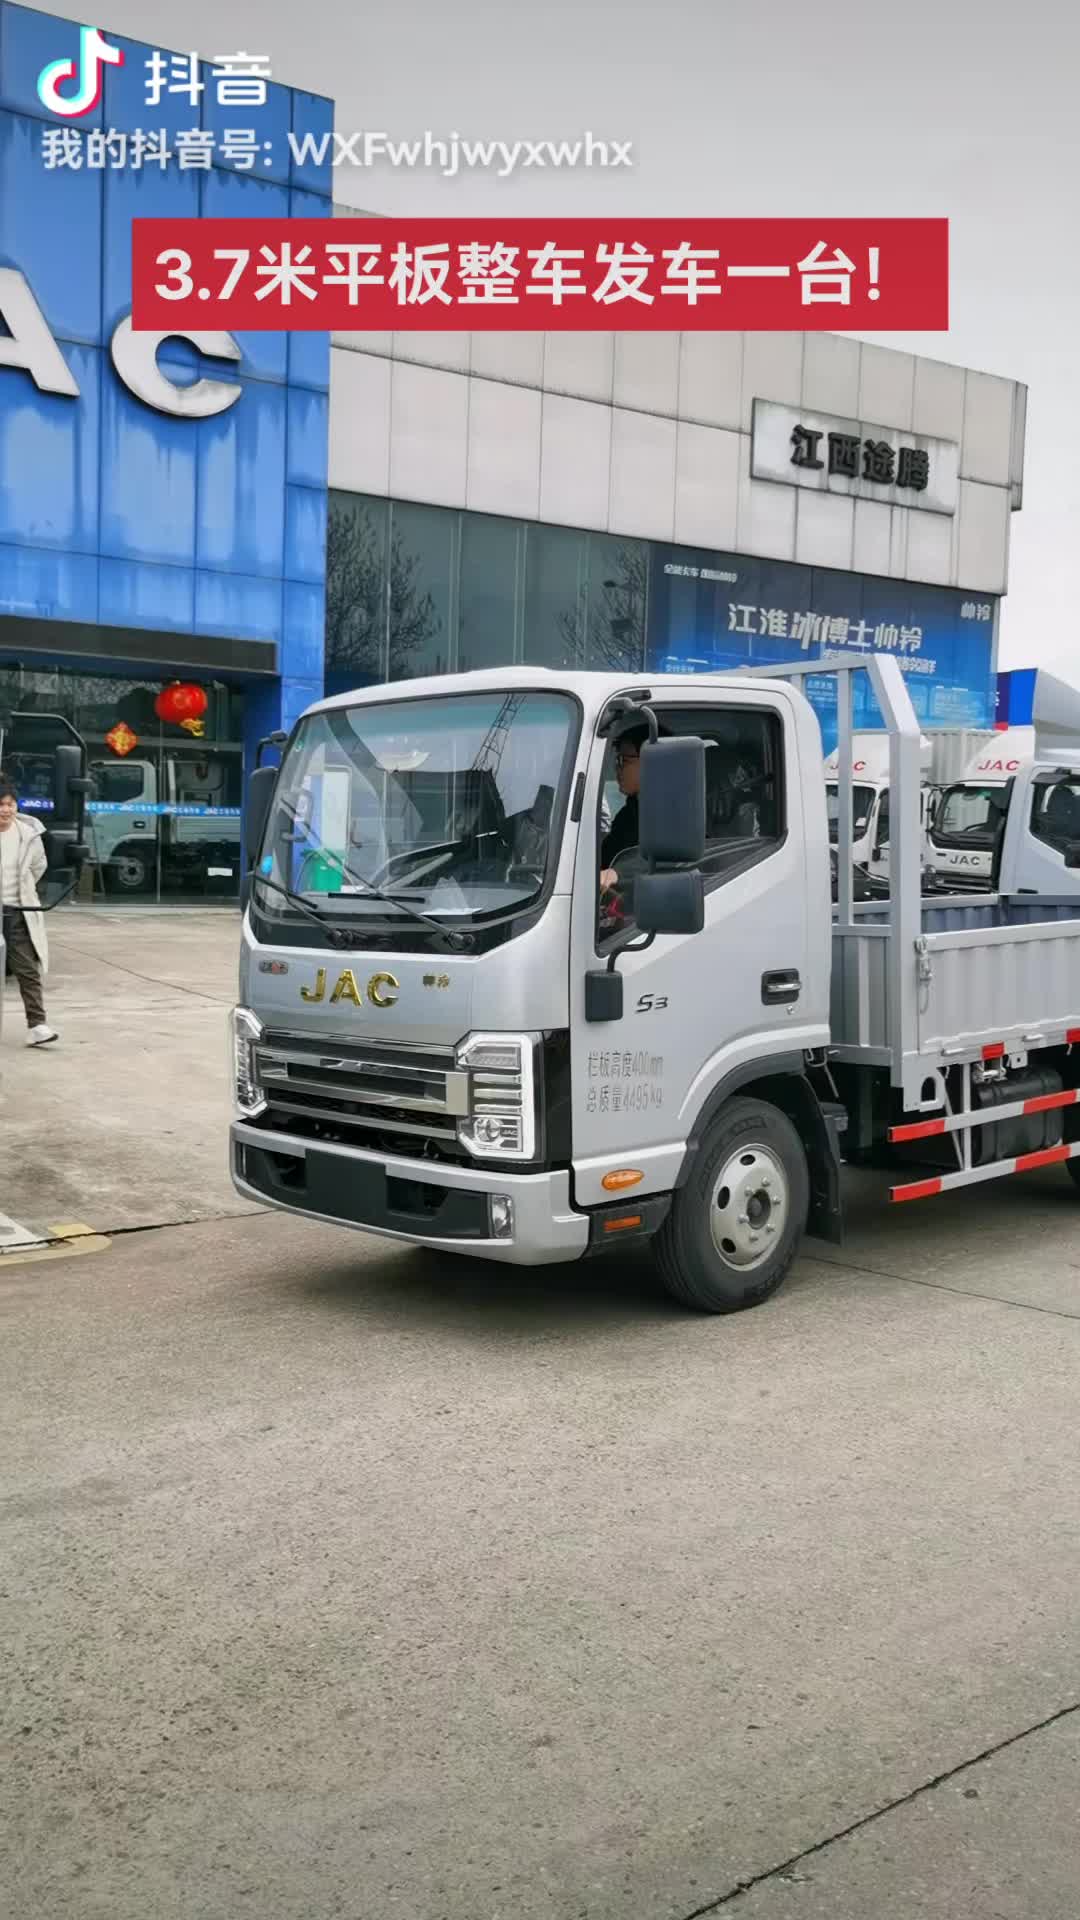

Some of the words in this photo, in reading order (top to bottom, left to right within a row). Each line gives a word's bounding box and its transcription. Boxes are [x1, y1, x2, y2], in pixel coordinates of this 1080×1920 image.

[790, 424, 929, 491] 江西途腾
[830, 761, 866, 771] JC
[978, 760, 1020, 771] JAC
[950, 855, 980, 865] JAC
[300, 967, 400, 1008] JAC
[635, 993, 669, 1013] S3
